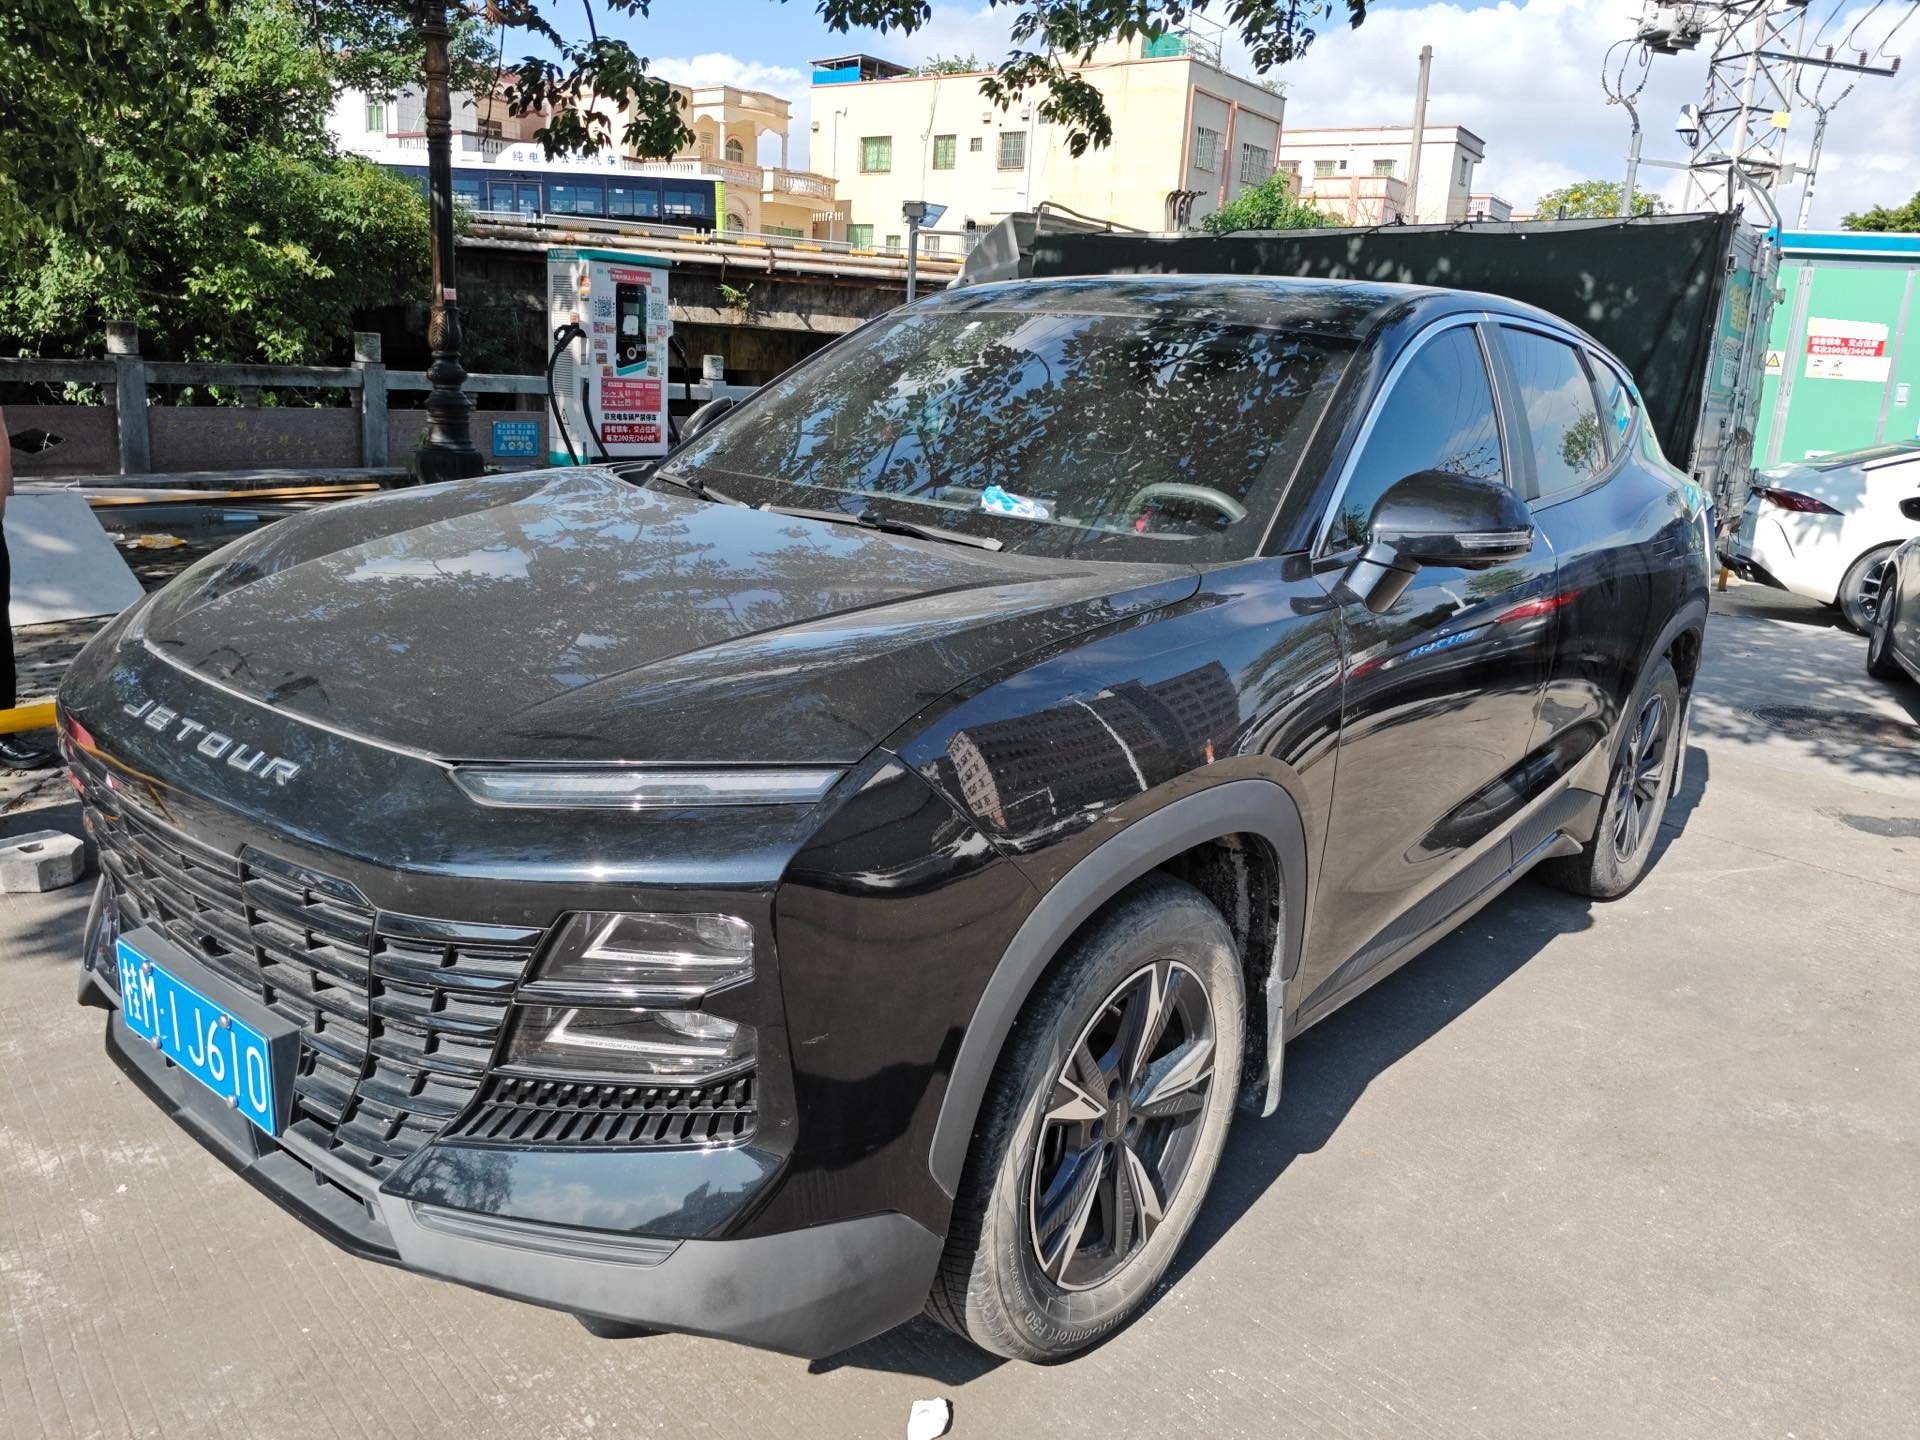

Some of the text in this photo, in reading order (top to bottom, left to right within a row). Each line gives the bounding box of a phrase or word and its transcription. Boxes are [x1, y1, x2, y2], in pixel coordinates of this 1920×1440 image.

[512, 151, 617, 166] 纯电公共汽车
[123, 700, 301, 786] JETOUR
[1024, 1310, 1049, 1337] F50
